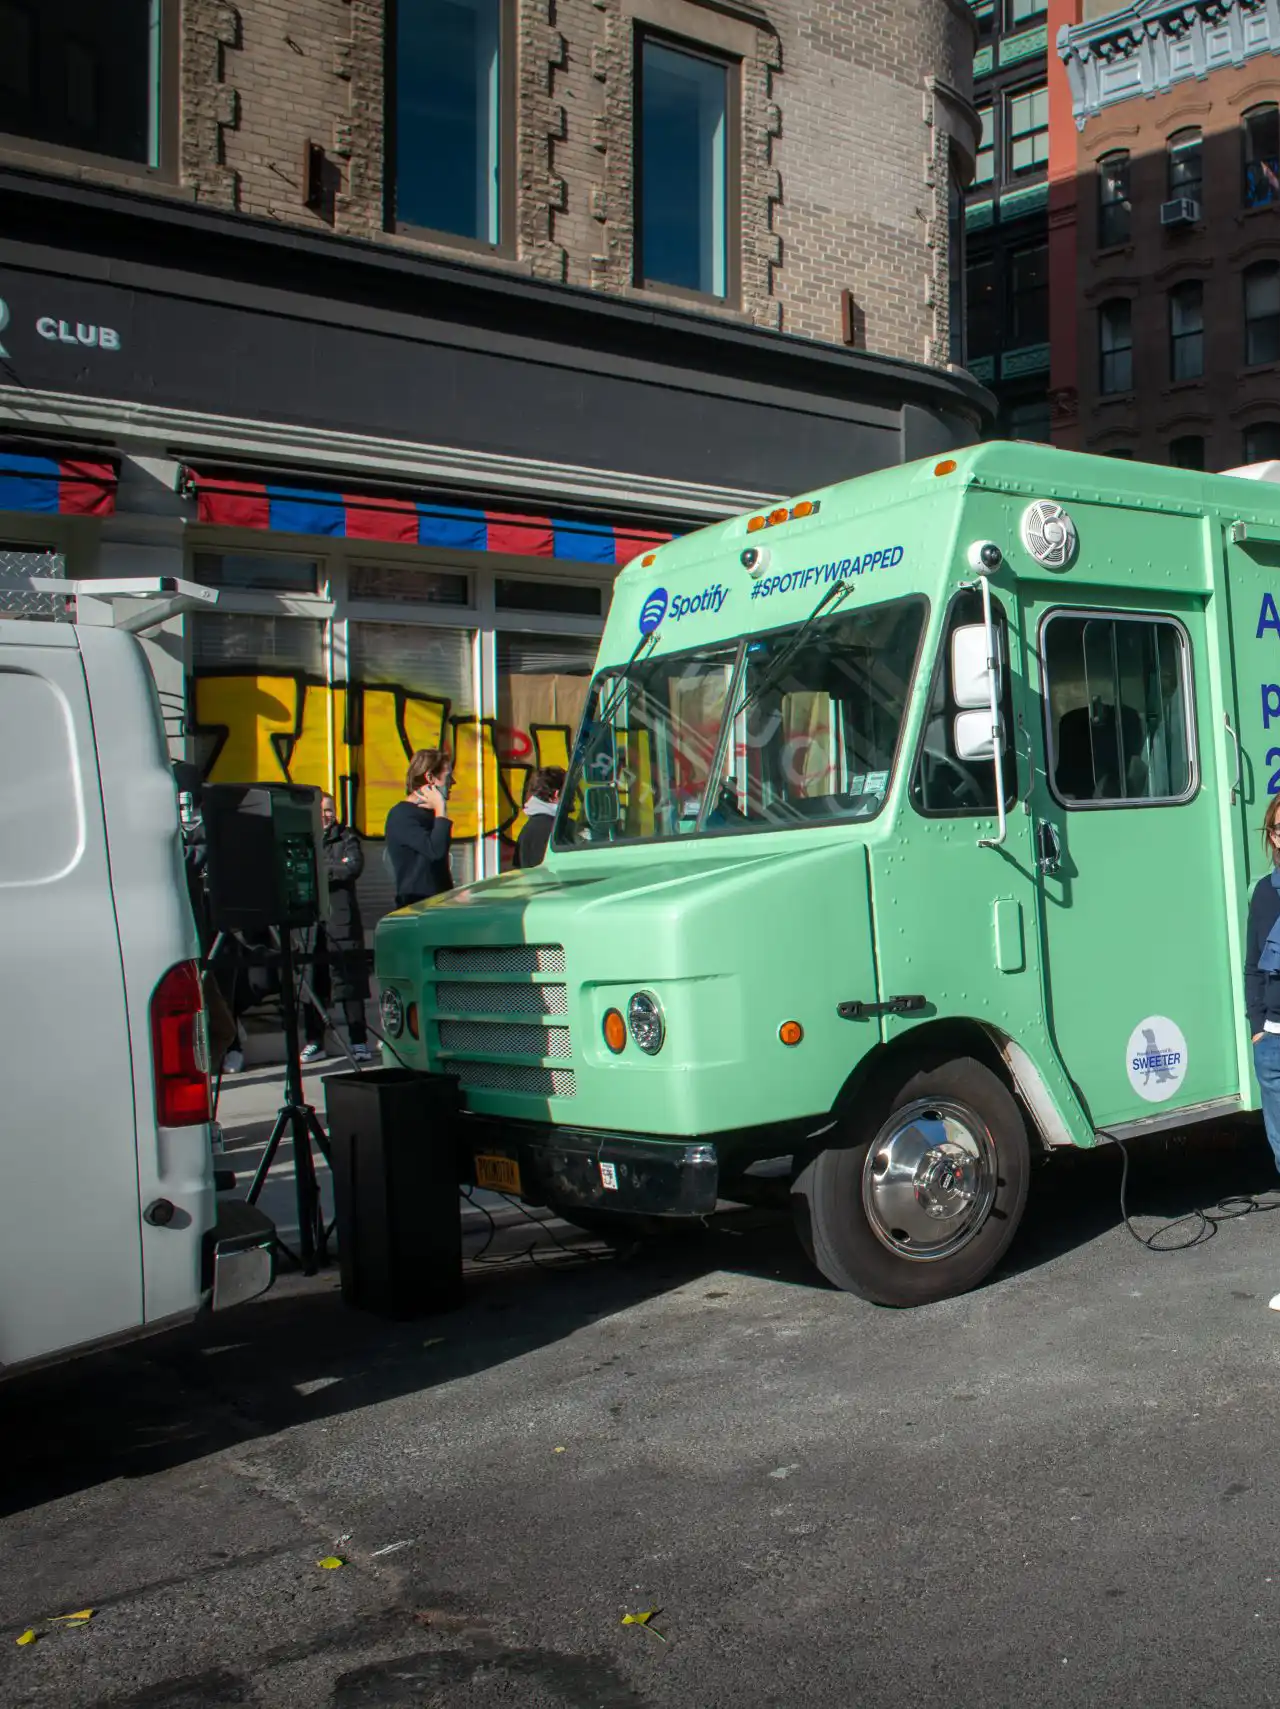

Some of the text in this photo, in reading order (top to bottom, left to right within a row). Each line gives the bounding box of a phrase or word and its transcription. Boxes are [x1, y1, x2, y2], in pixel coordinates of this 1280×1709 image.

[36, 316, 121, 351] CLUB
[751, 545, 905, 599] #SPOTIFYWRAPPED
[668, 584, 729, 621] Spotify
[1132, 1052, 1181, 1070] SWEETER
